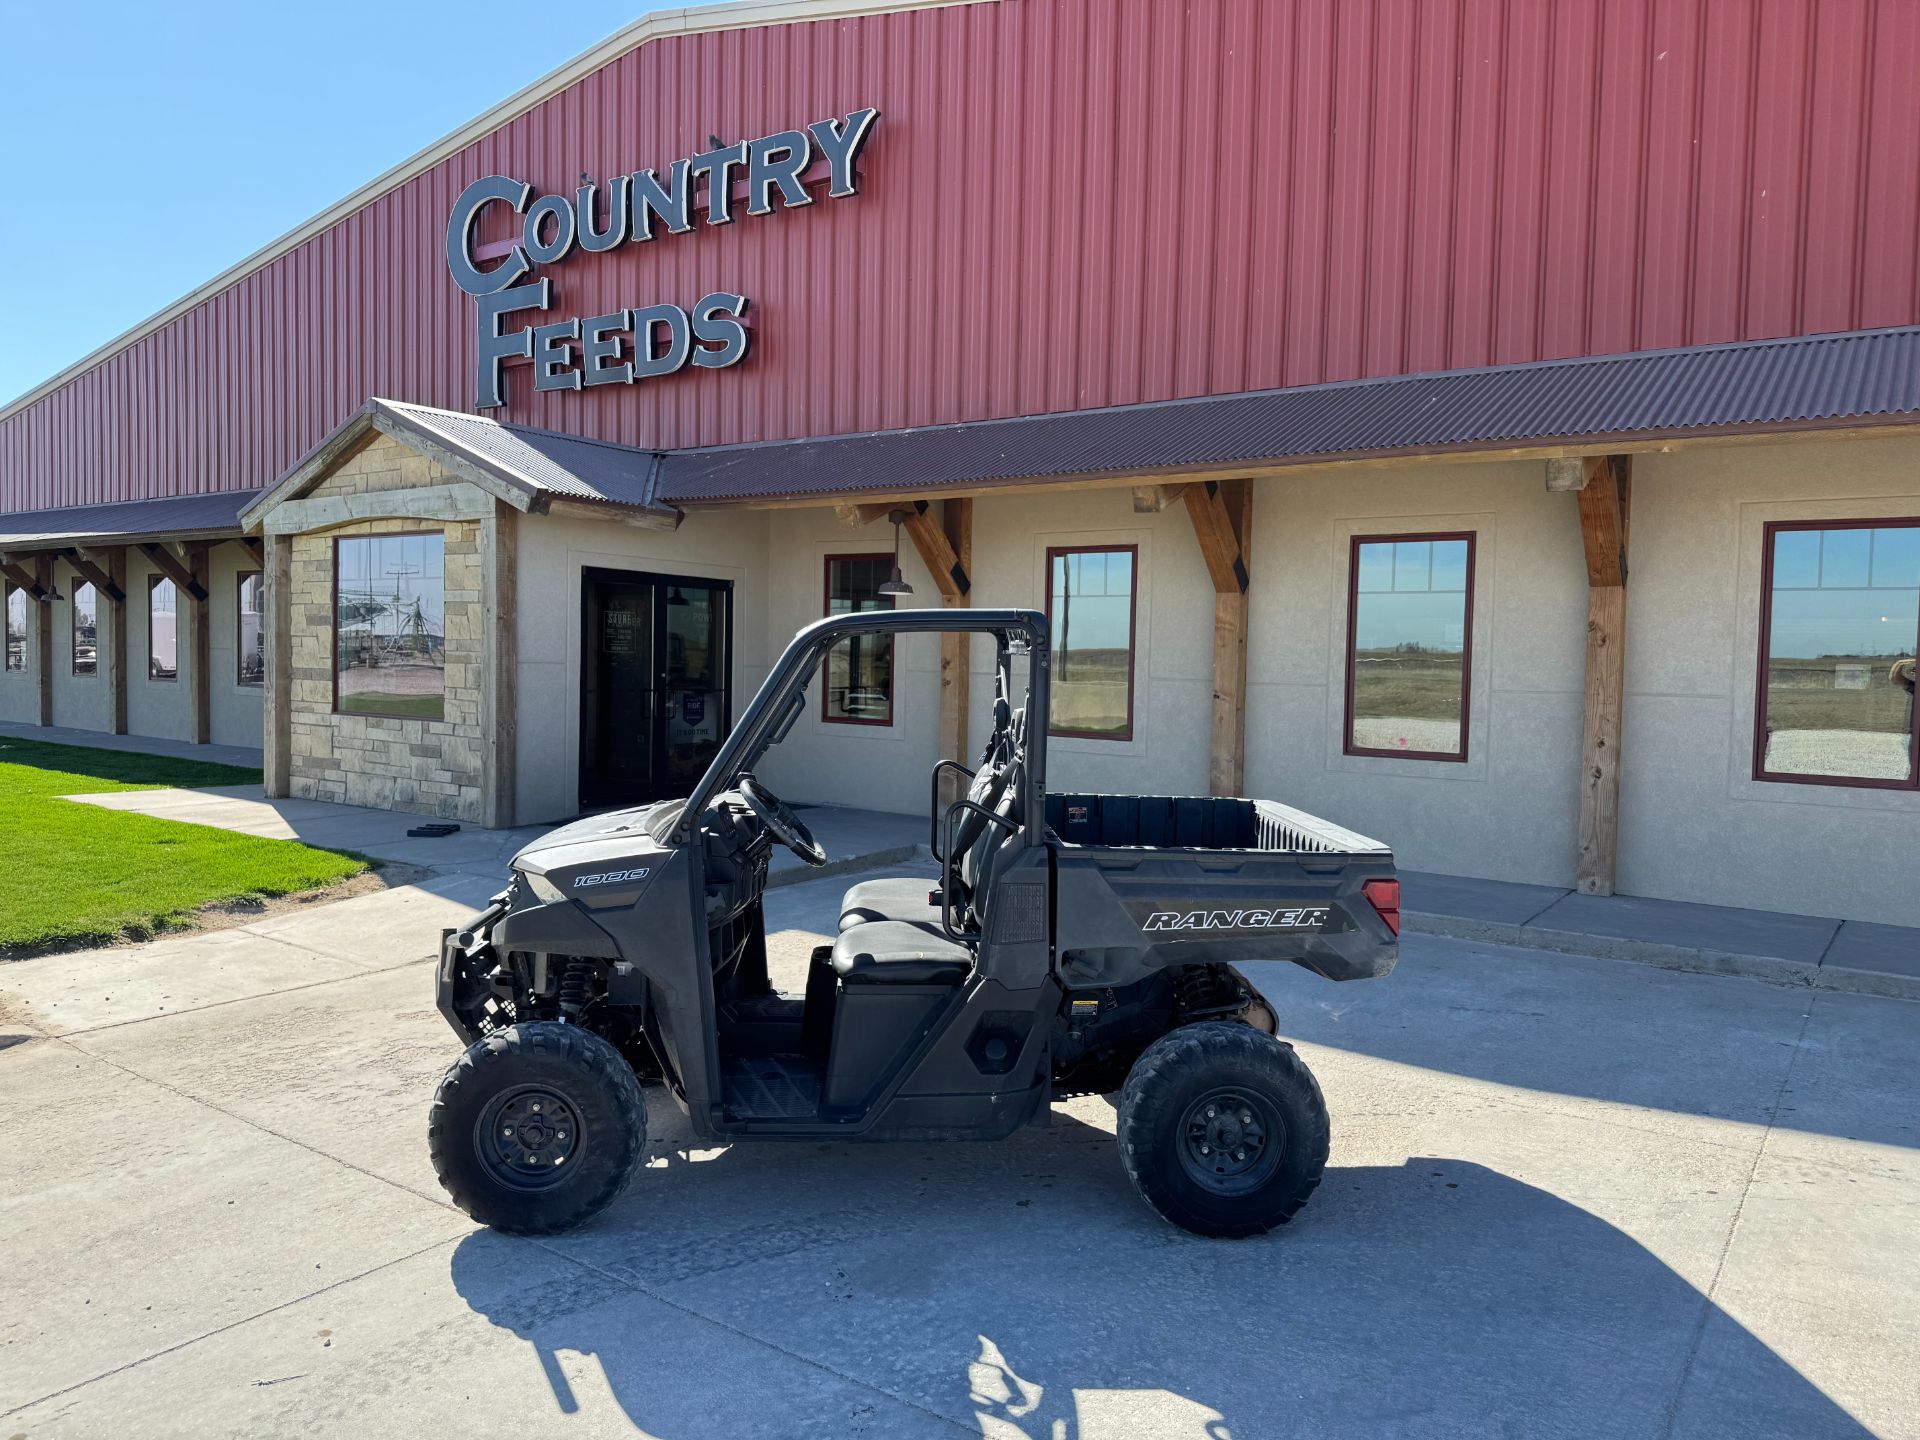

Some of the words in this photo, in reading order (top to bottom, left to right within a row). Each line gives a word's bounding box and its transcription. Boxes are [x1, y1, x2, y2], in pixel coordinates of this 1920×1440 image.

[446, 107, 880, 296] COUNTRY
[474, 277, 749, 408] FEEDS
[574, 868, 650, 888] 1000
[1142, 907, 1330, 931] RANGER
